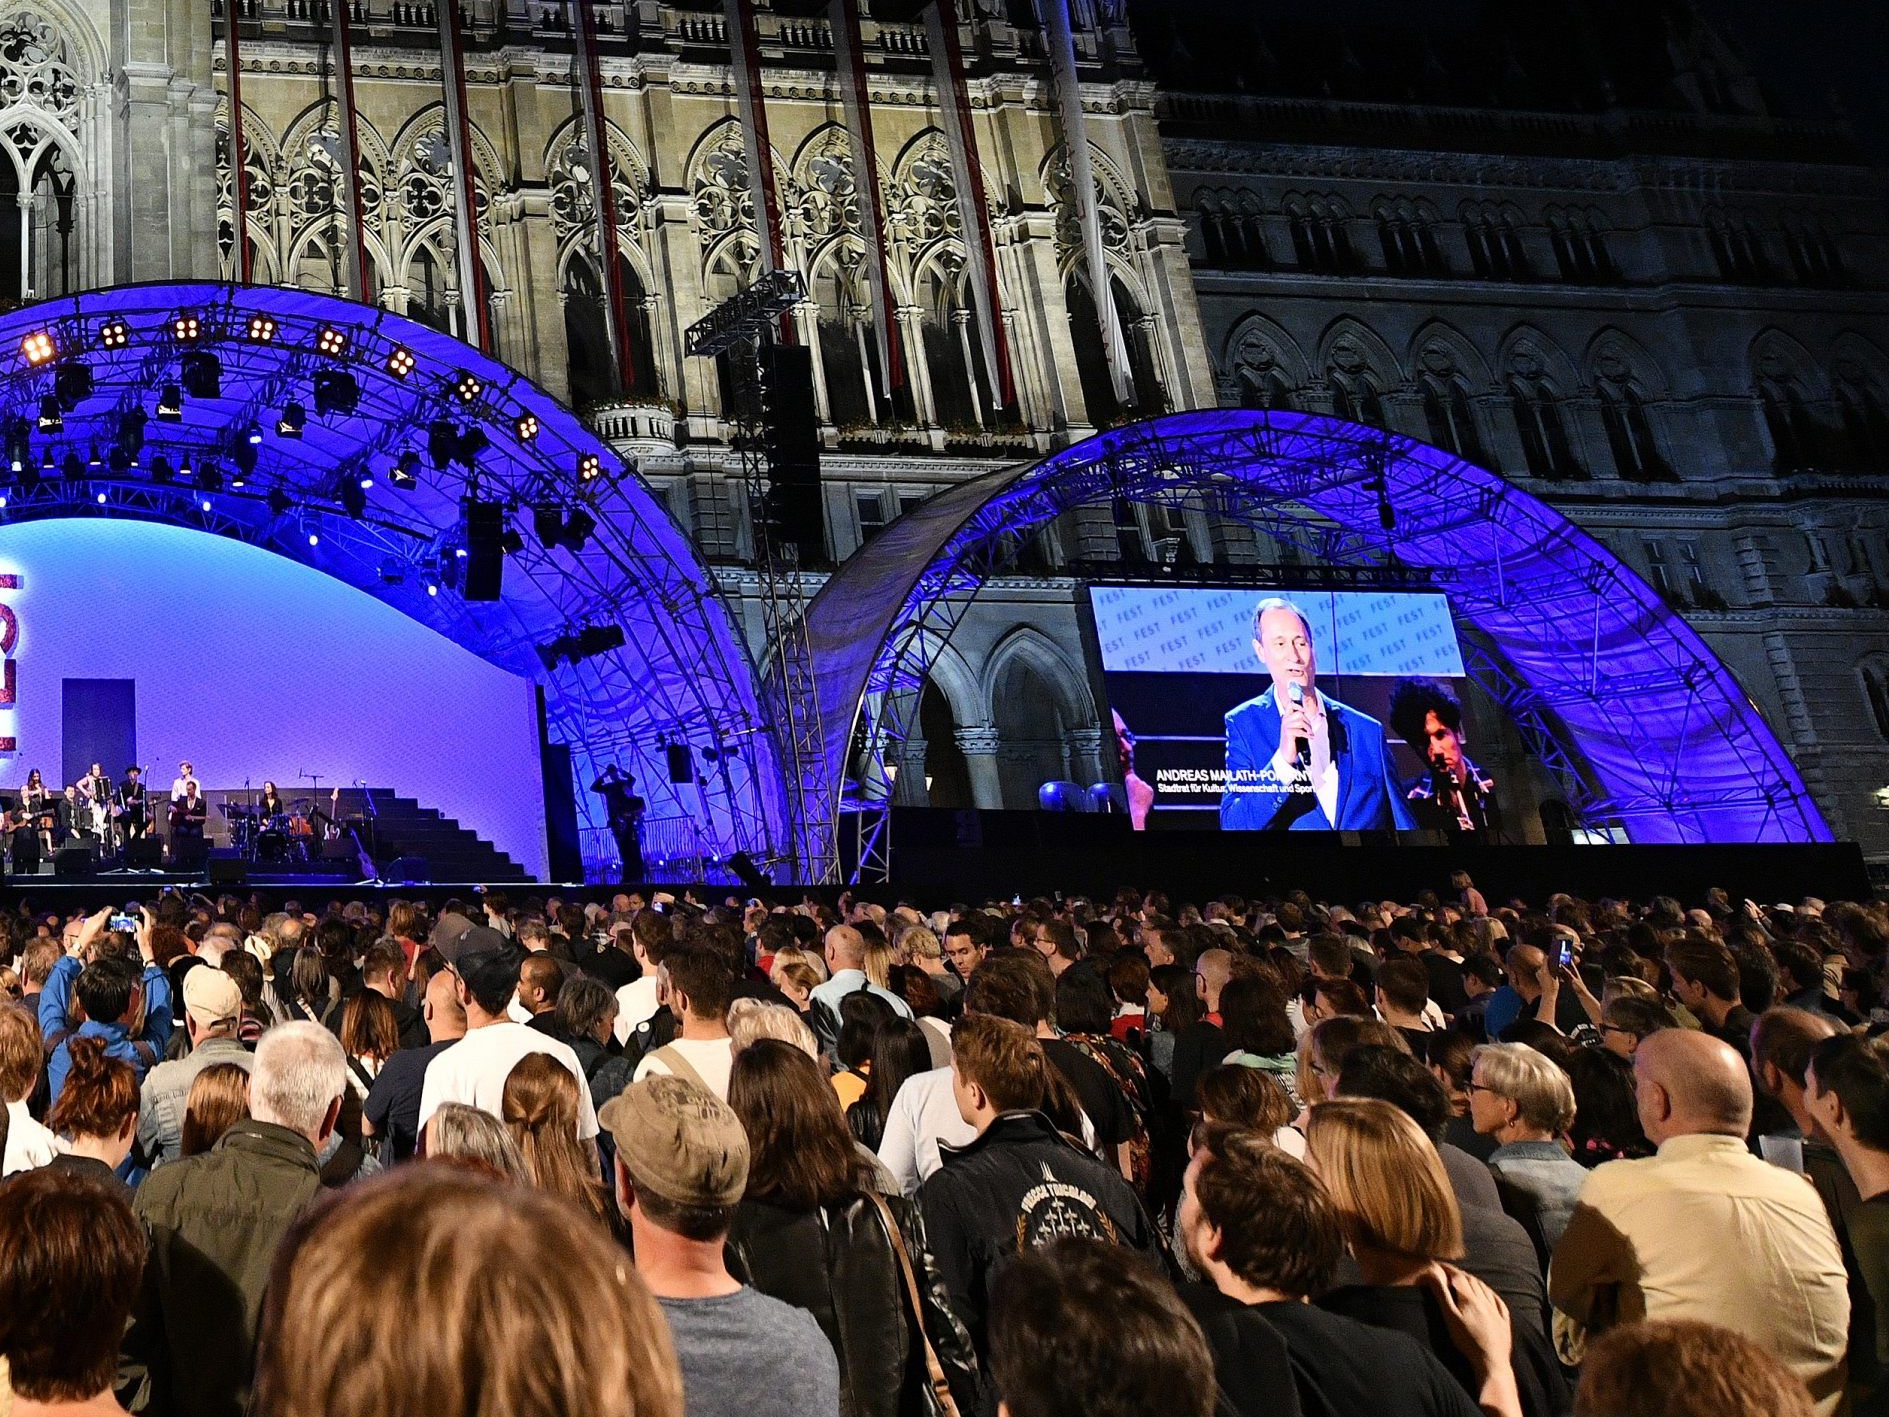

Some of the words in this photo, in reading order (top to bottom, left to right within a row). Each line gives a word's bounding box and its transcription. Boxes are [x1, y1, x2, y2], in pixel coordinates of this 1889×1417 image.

[1099, 589, 1125, 606] FEST
[1117, 605, 1143, 624] FEST
[1152, 591, 1180, 608] FEST
[1319, 595, 1344, 612] FEST
[1134, 622, 1161, 640] FEST
[1170, 607, 1197, 624] FEST
[1206, 592, 1233, 610] FEST
[1337, 610, 1362, 628] FEST
[1371, 595, 1397, 613] FEST
[1160, 636, 1188, 654] FEST
[1197, 621, 1224, 639] FEST
[1234, 608, 1253, 624] FES
[1363, 623, 1389, 641] FEST
[1397, 608, 1424, 625] FEST
[1105, 637, 1125, 652] EST
[1380, 639, 1406, 656] FEST
[1416, 624, 1443, 642] FEST
[1124, 651, 1151, 669] FEST
[1178, 653, 1205, 670] FEST
[1216, 638, 1242, 655] FEST
[1234, 655, 1259, 671] FEST
[1346, 654, 1371, 671] FEST
[1399, 656, 1424, 672] FEST
[1434, 644, 1455, 658] FES
[1156, 769, 1209, 782] ANDREAS
[1158, 783, 1190, 793] Stadtrat
[1190, 783, 1203, 793] für
[1203, 783, 1228, 795] Kultur,
[1228, 783, 1279, 793] Wissenschaft
[1280, 784, 1294, 793] und
